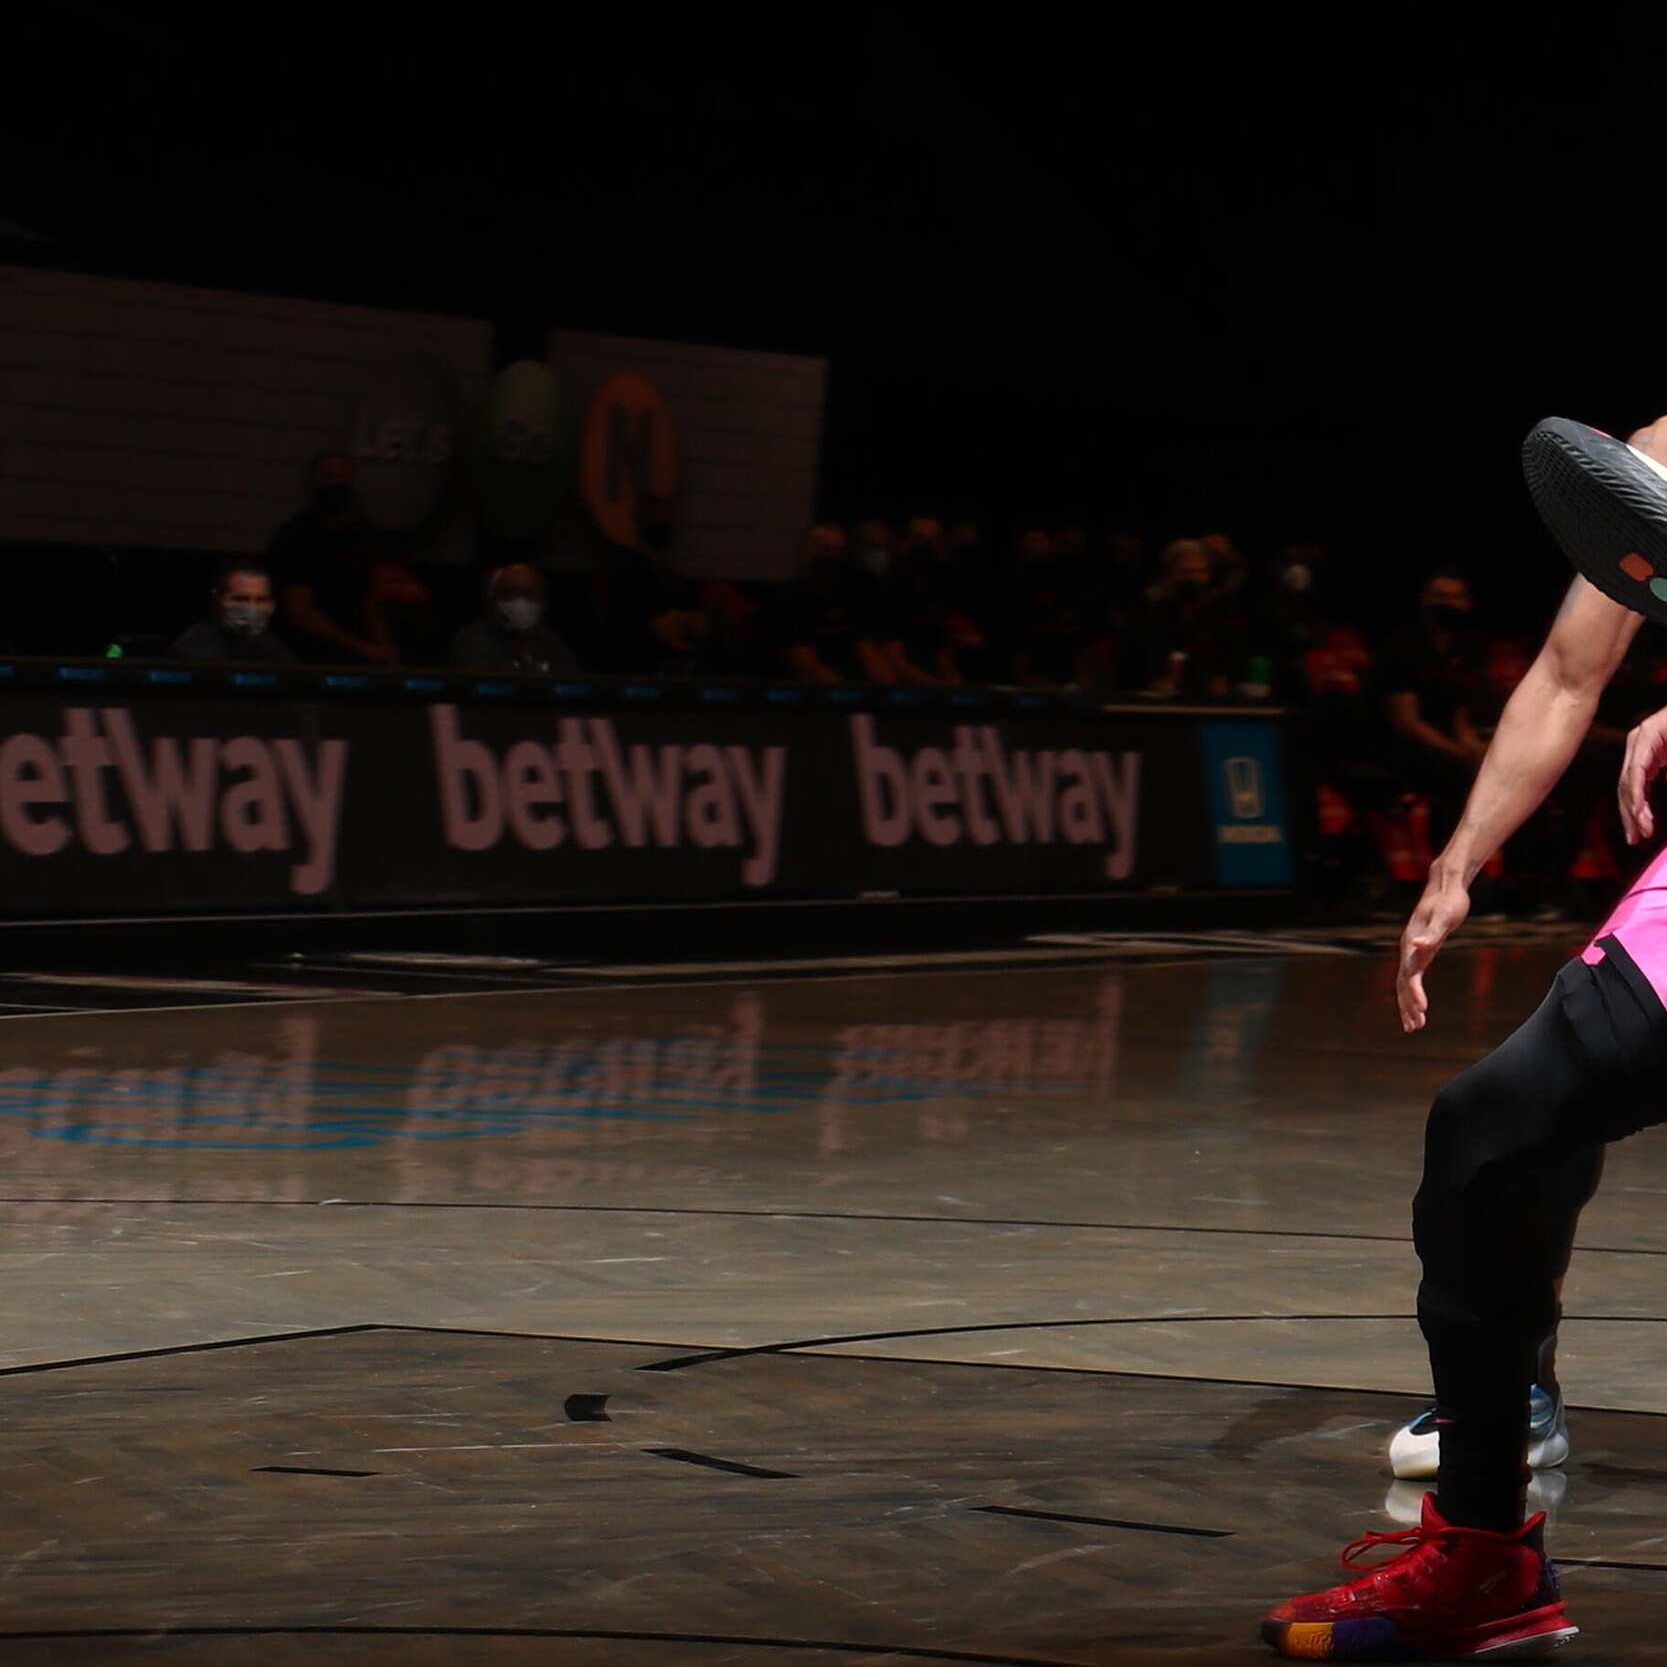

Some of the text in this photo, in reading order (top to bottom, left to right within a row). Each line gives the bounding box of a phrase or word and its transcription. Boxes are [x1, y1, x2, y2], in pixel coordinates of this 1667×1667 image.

[0, 703, 1144, 895] etway betway betway
